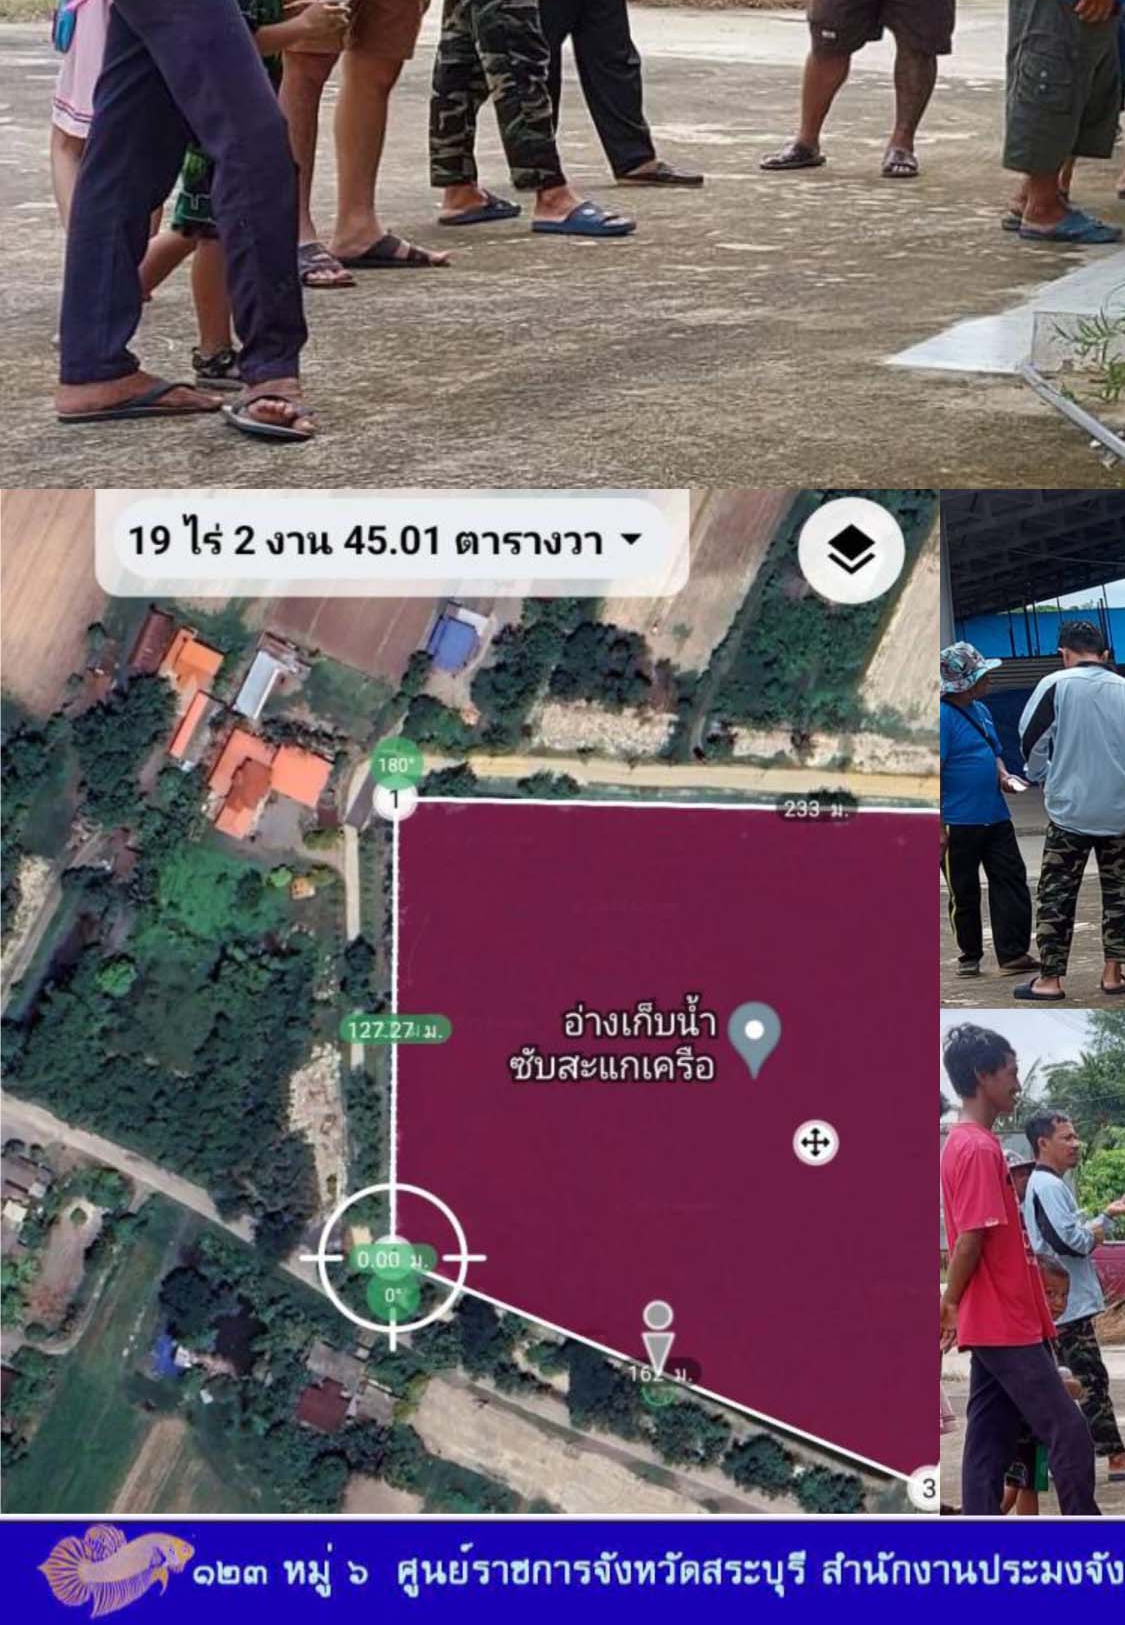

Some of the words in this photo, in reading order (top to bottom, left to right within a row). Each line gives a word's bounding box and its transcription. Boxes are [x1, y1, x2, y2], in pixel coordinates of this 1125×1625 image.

[129, 525, 171, 555] 19
[182, 513, 223, 555] ไร่
[234, 525, 255, 555] 2
[266, 531, 333, 555] งาน
[343, 525, 438, 555] 45.01
[455, 531, 602, 555] ตารางวา
[389, 789, 399, 809] 1
[783, 800, 820, 818] 233
[831, 803, 849, 818] ม.
[565, 995, 716, 1036] อ่างเก็บน้ำ
[509, 1047, 714, 1080] ซับสะแกเครือ
[357, 1250, 400, 1268] 0.00
[410, 1255, 429, 1268] ม.
[674, 1368, 693, 1382] ม.
[922, 1478, 936, 1499] 3
